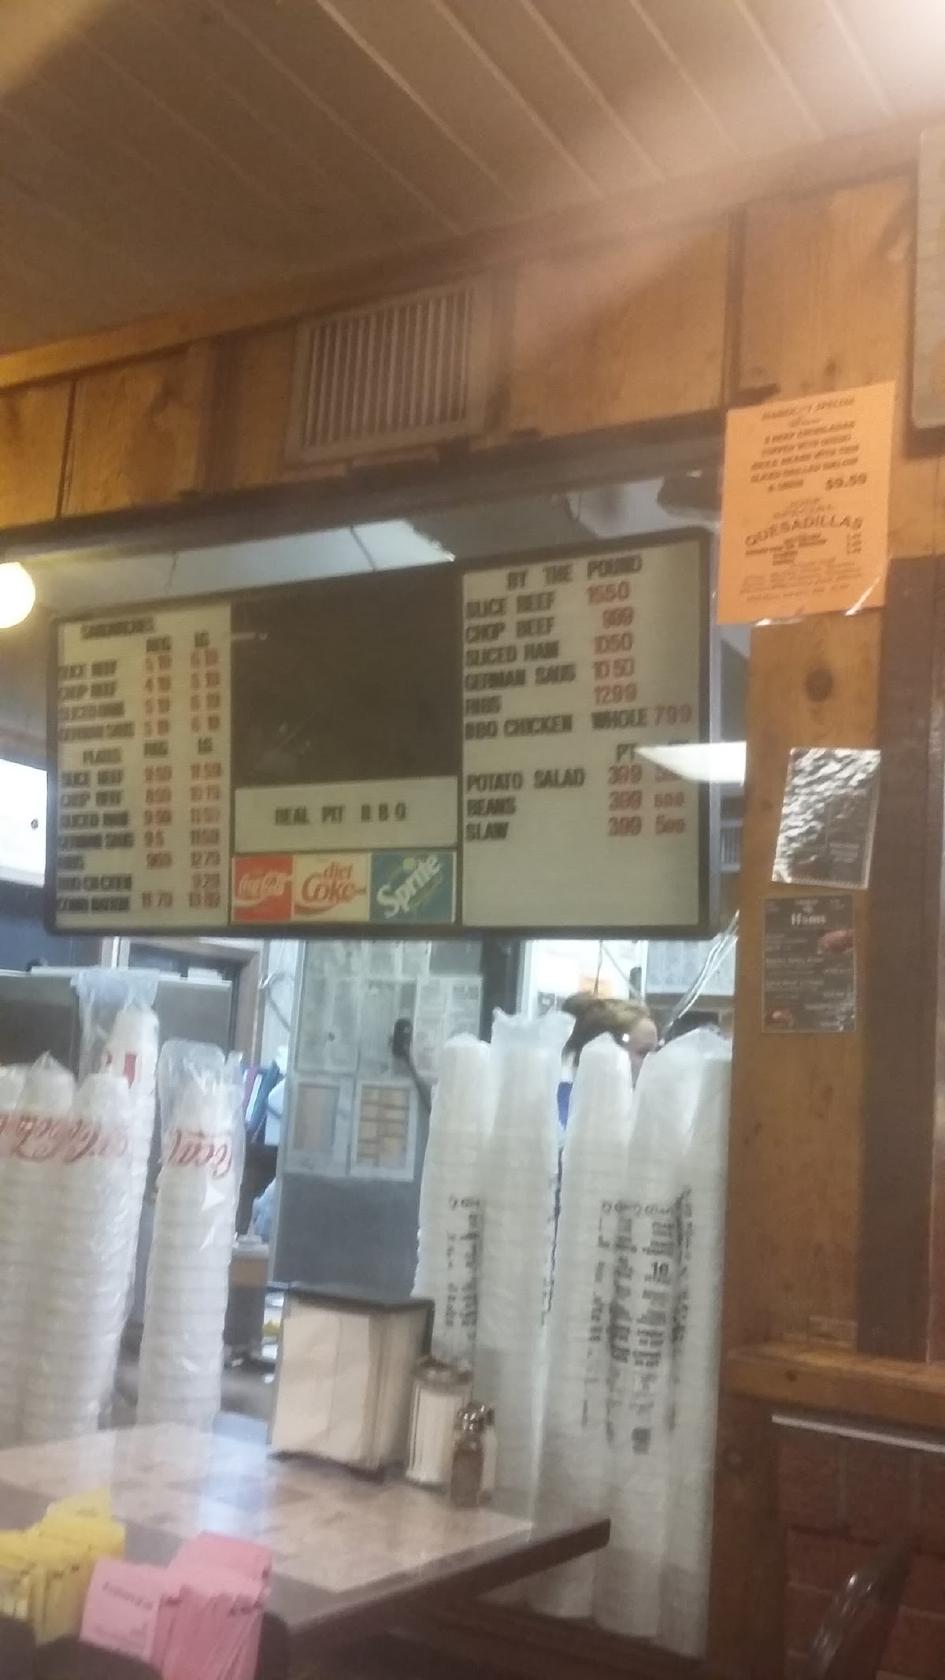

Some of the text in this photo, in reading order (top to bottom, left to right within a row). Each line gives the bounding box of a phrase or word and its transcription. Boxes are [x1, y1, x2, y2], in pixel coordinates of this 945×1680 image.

[745, 515, 864, 547] QUESADILLAS
[587, 555, 642, 579] POUND
[516, 591, 556, 613] BEEF
[466, 622, 506, 643] CHOP
[516, 617, 554, 637] BEEF
[465, 645, 517, 666] SLICED
[524, 641, 559, 660] HAM
[503, 714, 573, 737] CHICKEN
[591, 708, 648, 730] WHOLE
[466, 772, 523, 792] POTATO
[534, 767, 585, 788] SALAD
[466, 797, 516, 817] BEANS
[466, 822, 509, 841] SLAW
[300, 872, 366, 903] Coke
[377, 854, 442, 919] Sprite
